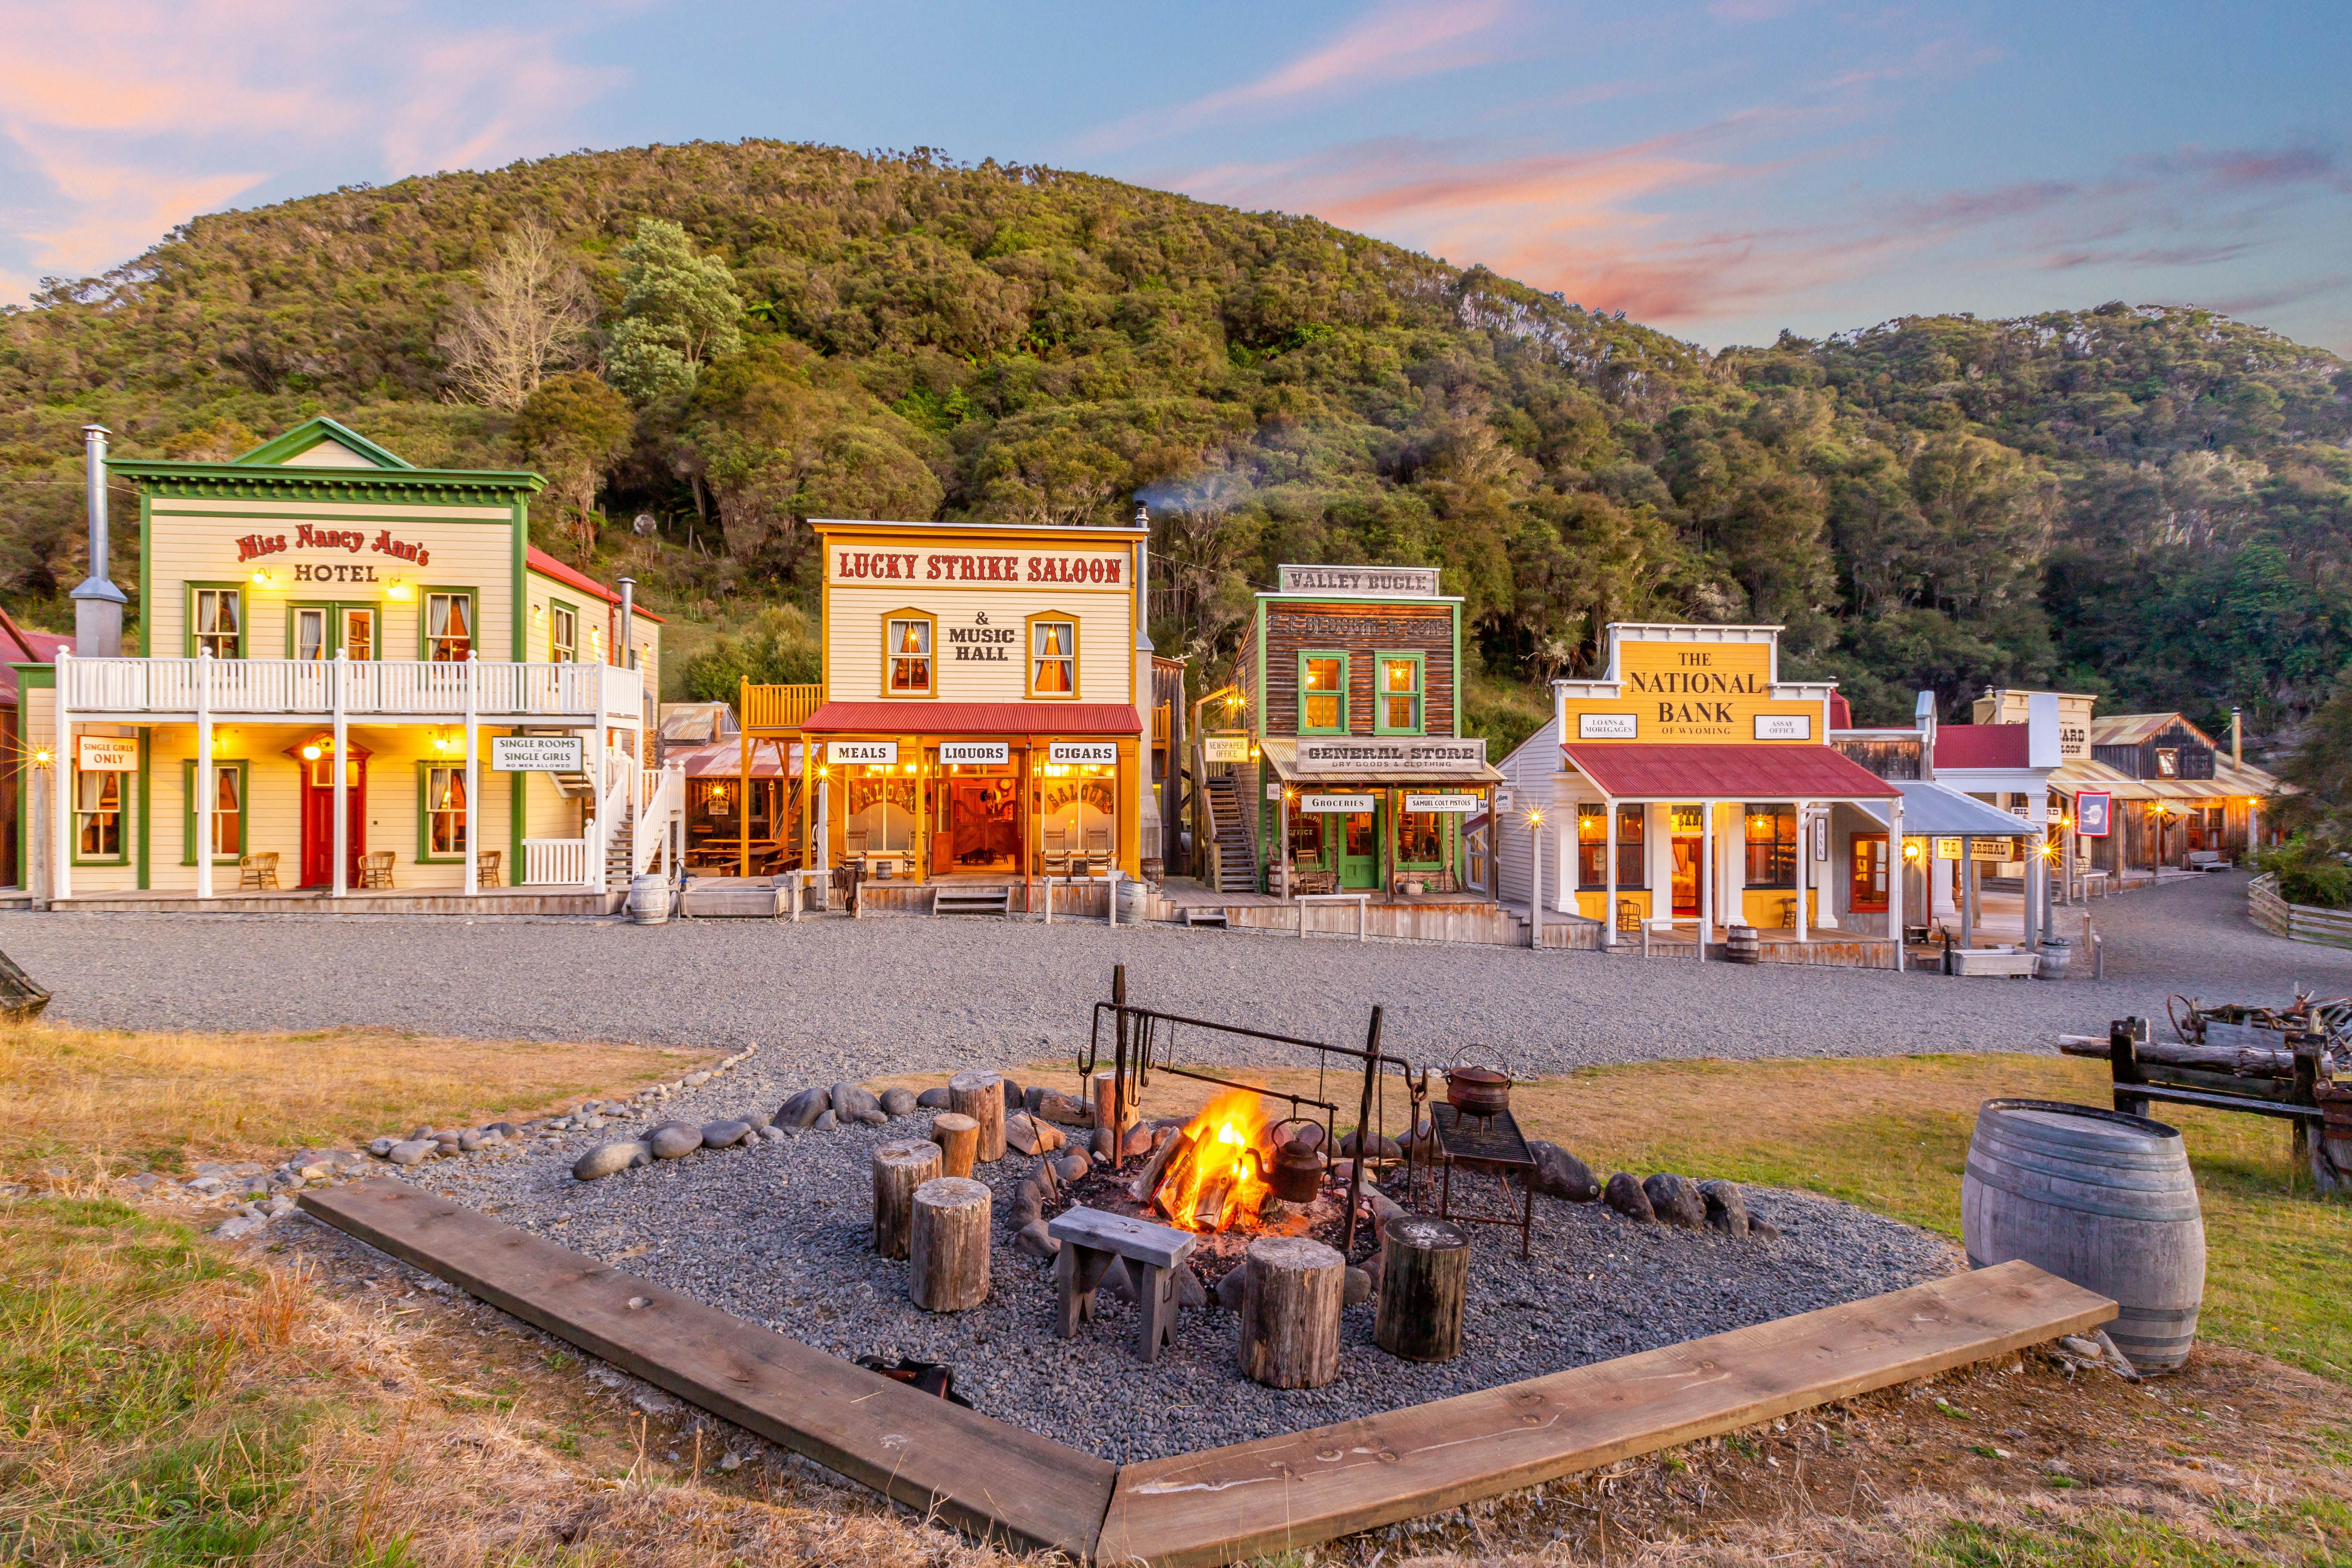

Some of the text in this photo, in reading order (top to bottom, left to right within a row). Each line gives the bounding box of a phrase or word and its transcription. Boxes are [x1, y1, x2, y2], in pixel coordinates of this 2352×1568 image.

[235, 524, 429, 566] Miss Nancy Ann's
[294, 564, 379, 582] HOTEL
[839, 553, 1122, 583] LUCKY STRIKE SALOON
[1290, 573, 1426, 590] VALLEY BUGLE
[975, 611, 990, 625] &
[1386, 617, 1400, 635] &
[949, 628, 1015, 643] MUSIC
[956, 646, 1008, 661] HALL
[1678, 653, 1711, 666] THE
[1629, 672, 1762, 693] NATIONAL
[1657, 702, 1734, 723] BANK
[839, 747, 886, 758] MEALS
[945, 747, 1004, 758] LIQUORS
[1209, 741, 1244, 750] NEWSPAPER
[2061, 745, 2081, 753] LOON
[94, 754, 124, 764] ONLY
[1055, 748, 1112, 758] CIGARS
[1309, 748, 1474, 760] GENERAL STORE
[1047, 784, 1111, 808] SALOON
[1312, 798, 1364, 807] GROCERIES
[1288, 813, 1321, 824] ELEGRAPH
[1678, 810, 1703, 826] BAN
[1943, 842, 2005, 855] U.S. ARSHAL
